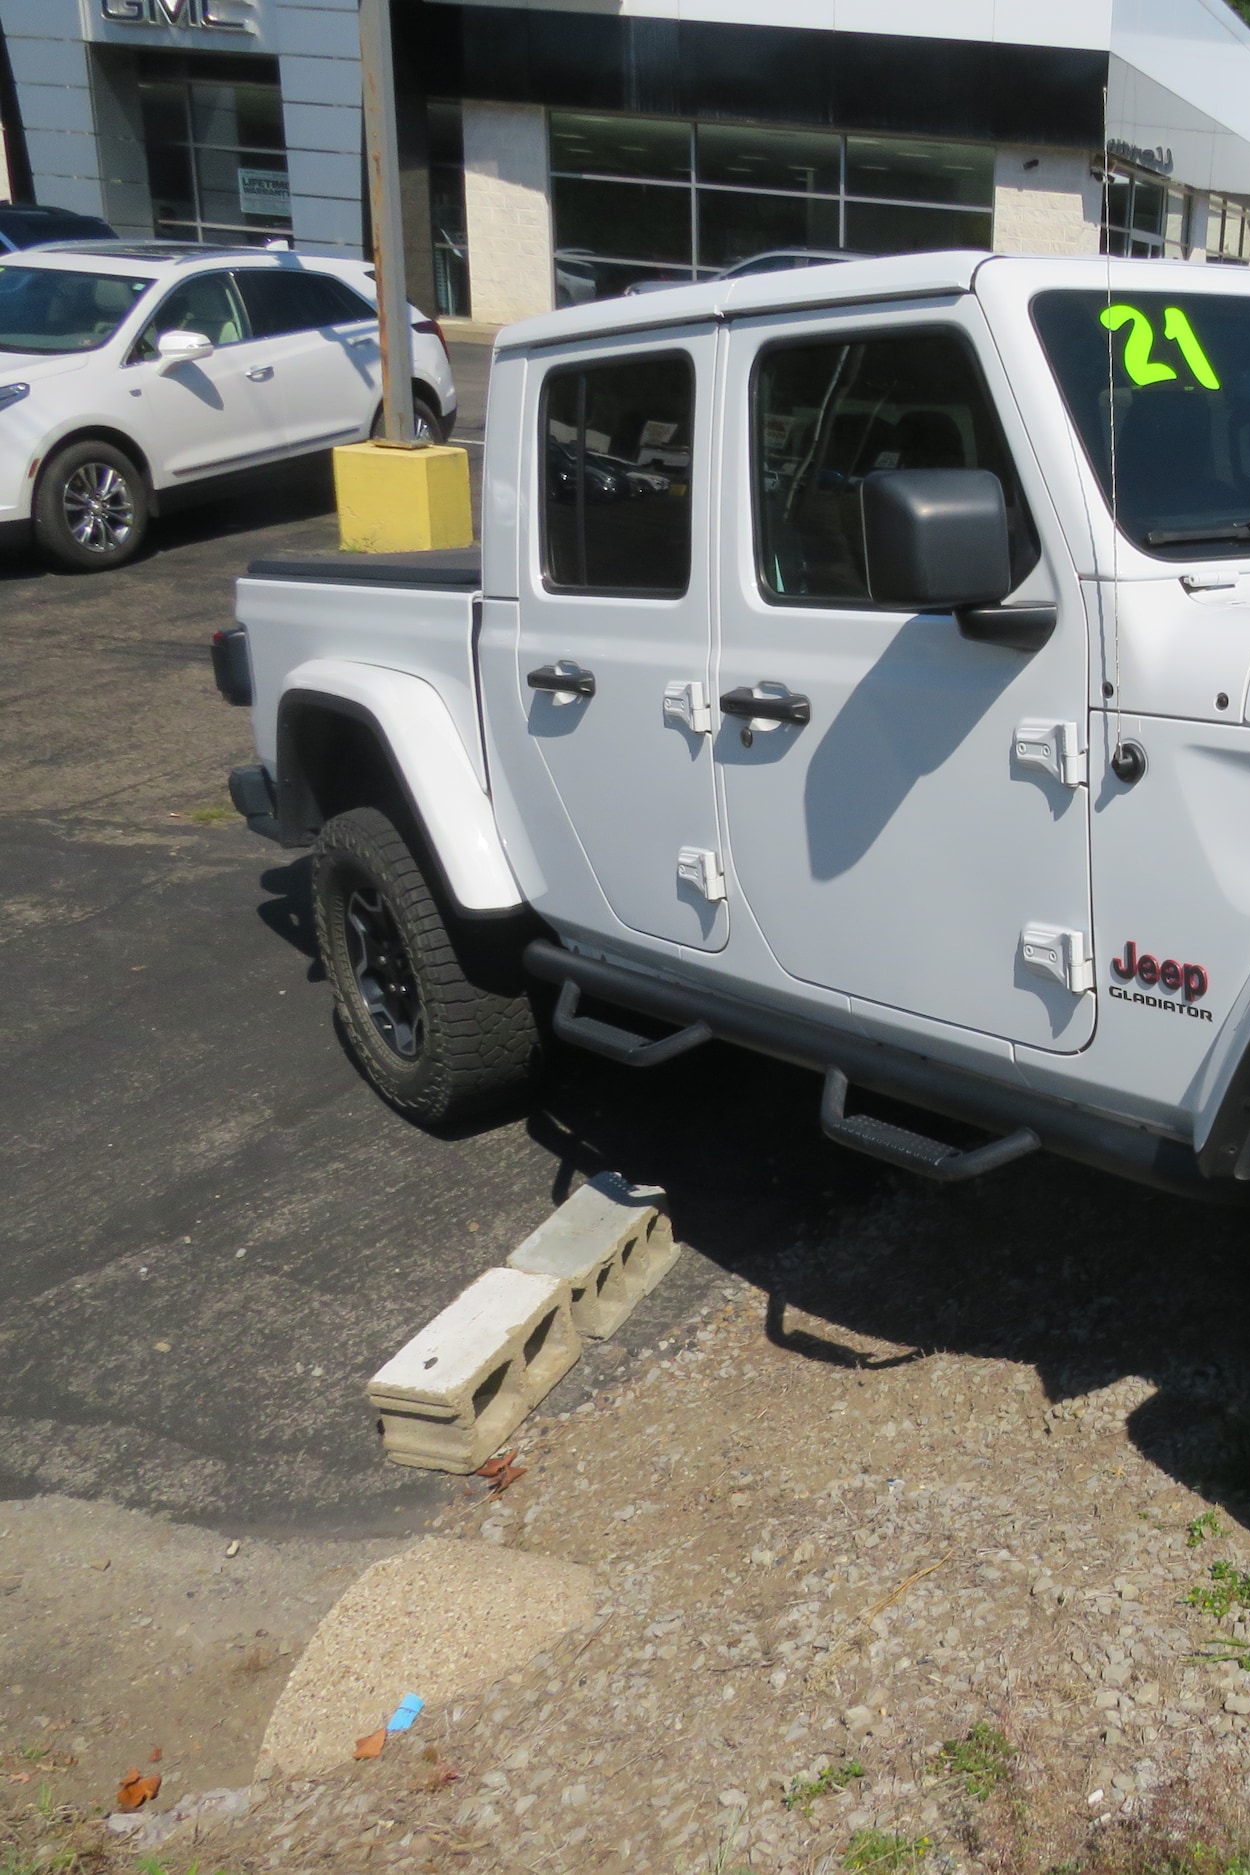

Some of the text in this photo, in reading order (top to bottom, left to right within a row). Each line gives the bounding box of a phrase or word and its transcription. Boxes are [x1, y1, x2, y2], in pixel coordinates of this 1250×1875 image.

[1099, 304, 1222, 391] 21
[1111, 941, 1208, 1003] Jeep
[1108, 985, 1214, 1023] GLADIATOR
